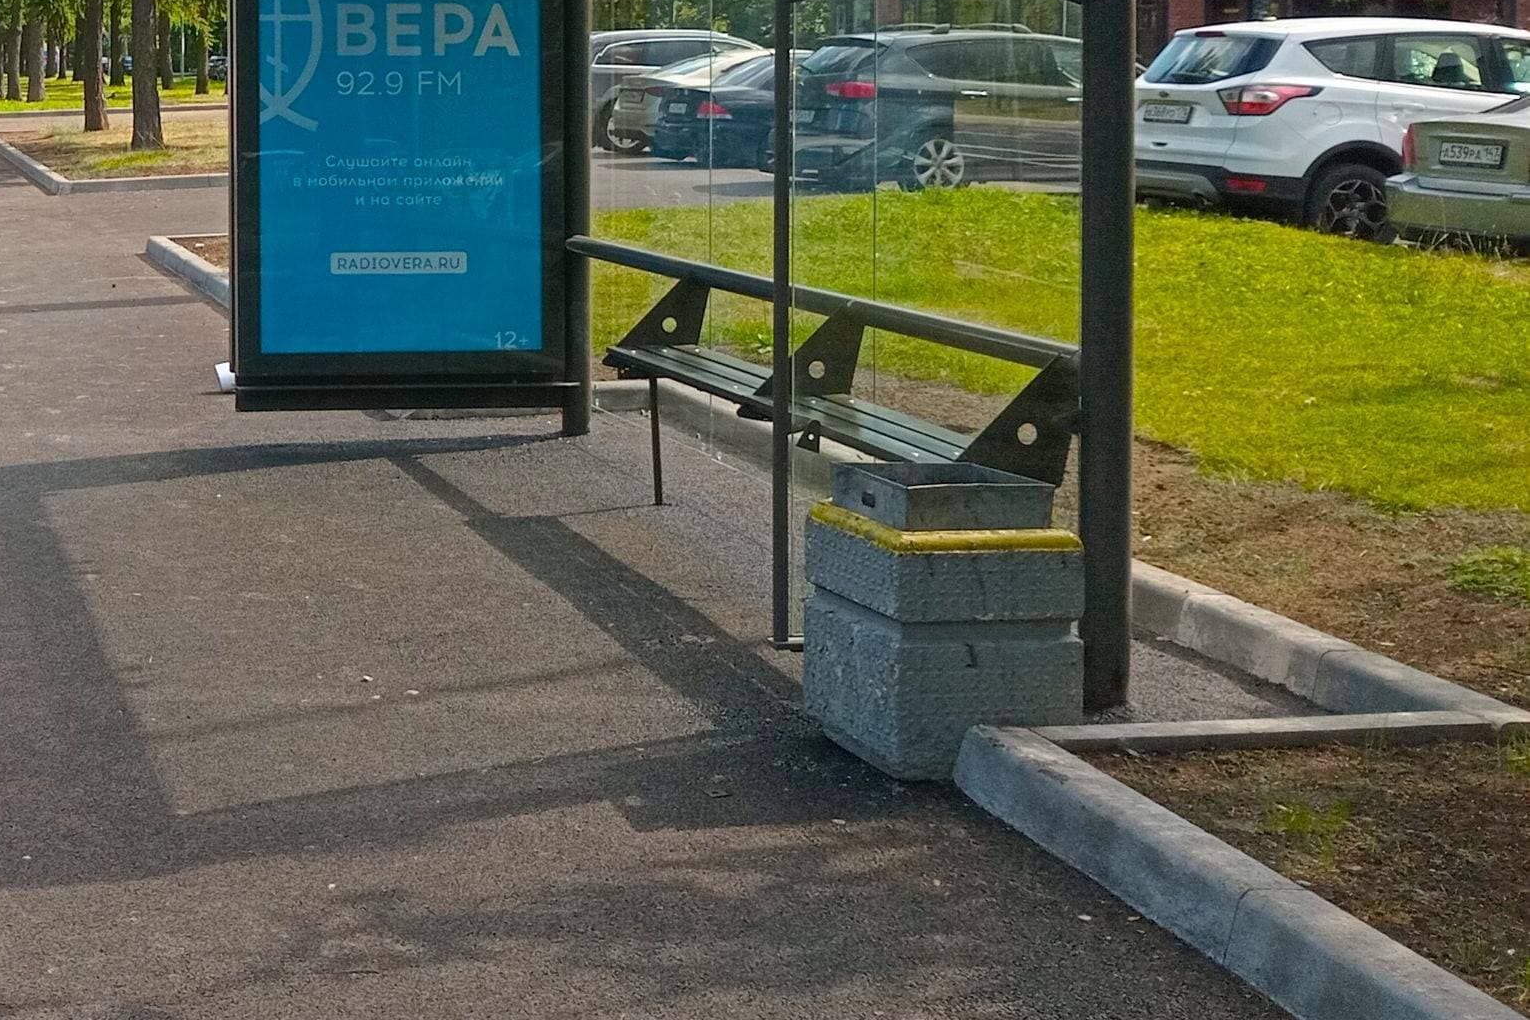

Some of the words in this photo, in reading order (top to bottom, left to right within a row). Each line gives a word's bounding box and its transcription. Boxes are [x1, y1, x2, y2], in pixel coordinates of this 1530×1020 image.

[336, 2, 521, 57] ВЕРА
[336, 70, 403, 96] 92.9
[418, 70, 463, 96] FM
[325, 155, 408, 170] Слушайте
[413, 154, 472, 168] онлайн
[293, 177, 301, 187] в
[307, 174, 397, 187] мобильном
[355, 196, 365, 206] и
[370, 196, 390, 206] на
[396, 193, 442, 206] сайте
[336, 257, 460, 270] RADIOVERA.RU
[494, 330, 529, 349] 12+
